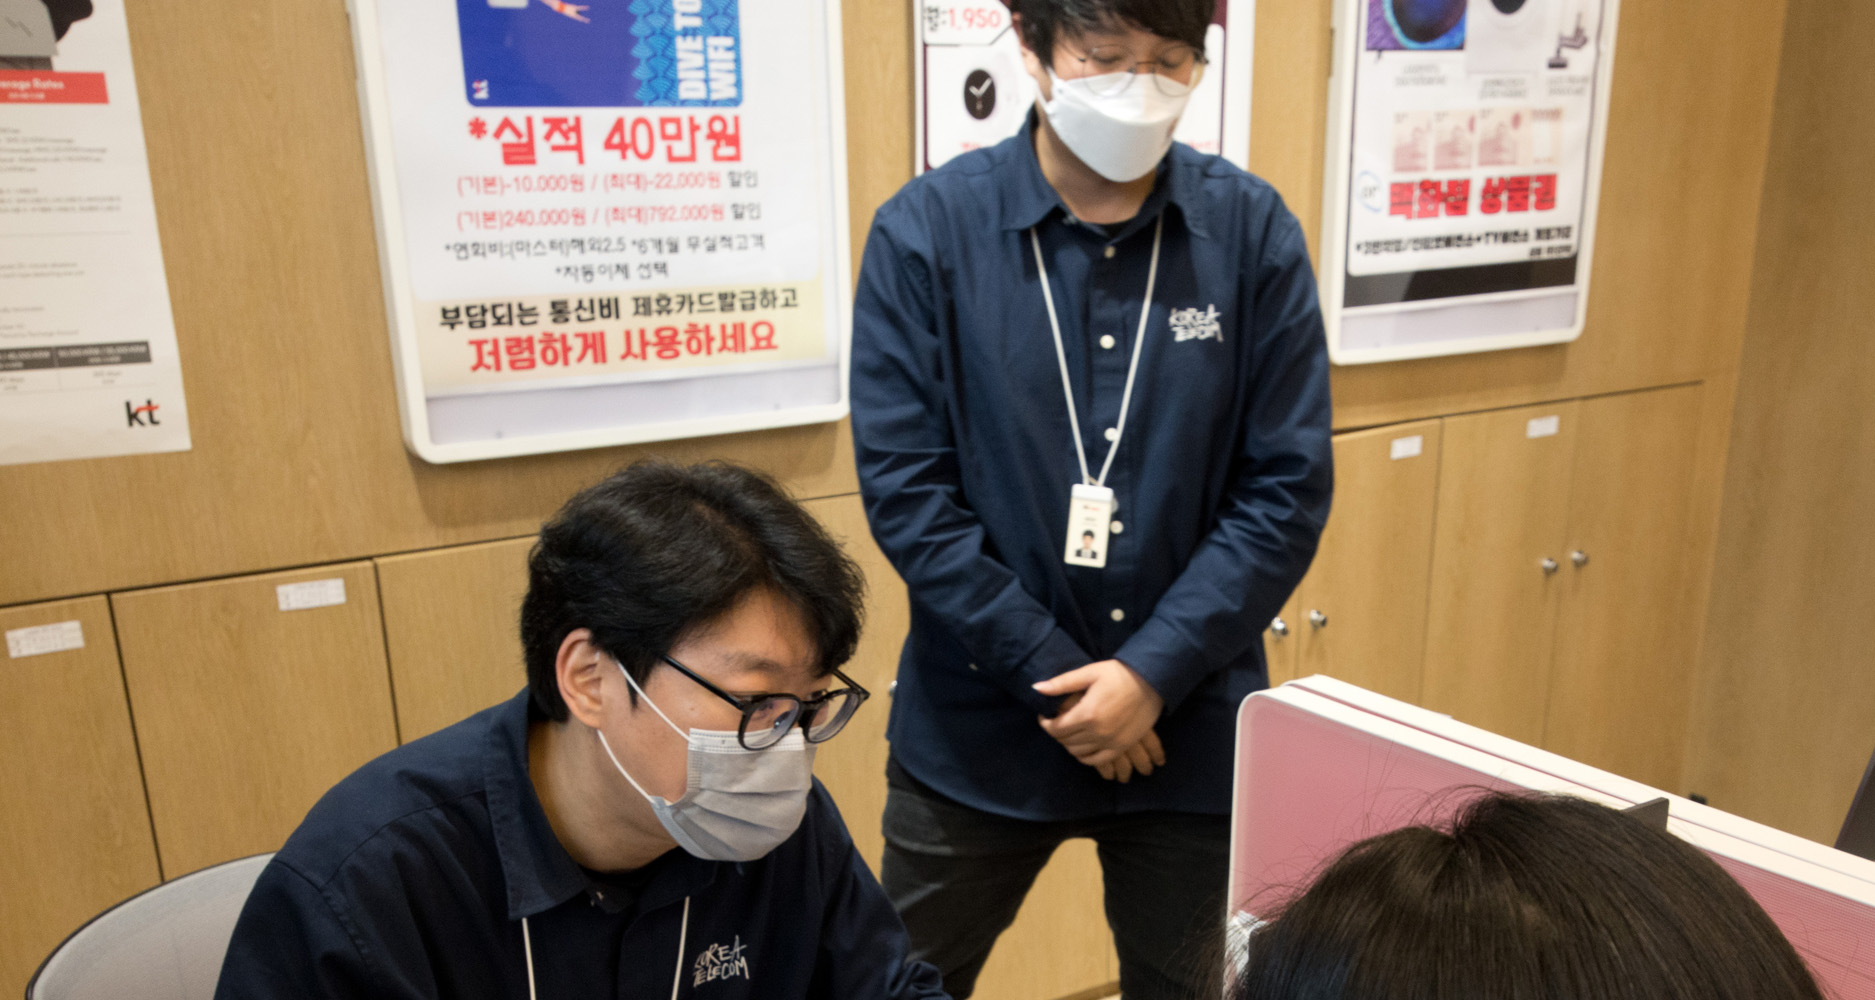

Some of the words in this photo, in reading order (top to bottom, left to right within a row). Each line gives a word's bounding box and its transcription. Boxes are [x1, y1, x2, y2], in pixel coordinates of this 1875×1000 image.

[675, 35, 706, 100] DIVE
[706, 36, 738, 100] WIFI
[603, 114, 742, 163] 40만원
[439, 302, 539, 330] 부담되는
[548, 296, 620, 324] 통신비
[632, 287, 799, 318] 제휴카드발급하고
[468, 329, 607, 372] 저렴하게
[620, 320, 779, 361] 사용하세요
[125, 398, 161, 428] kt
